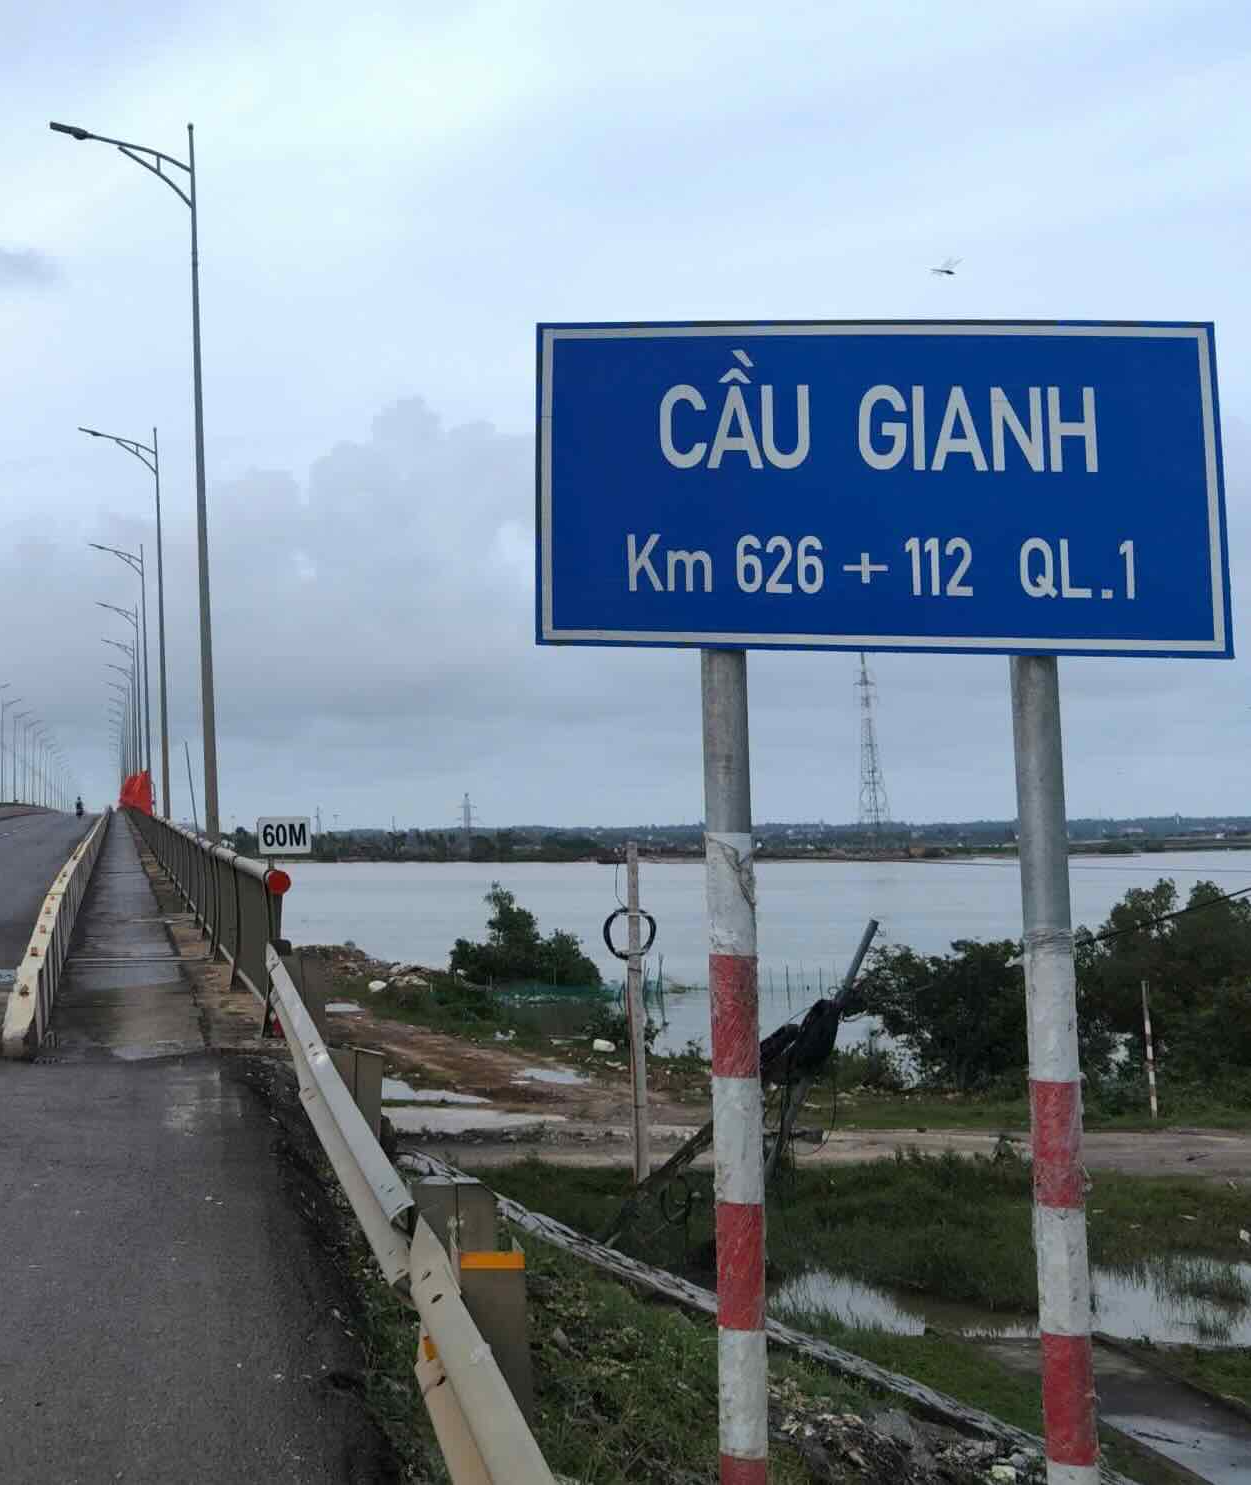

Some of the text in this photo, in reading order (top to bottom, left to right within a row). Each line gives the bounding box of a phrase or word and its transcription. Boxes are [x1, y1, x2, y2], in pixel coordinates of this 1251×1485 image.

[659, 349, 1099, 473] CẦU GIANH
[626, 533, 1138, 600] Km 626 + 112 QL.1
[262, 823, 307, 847] 60M
